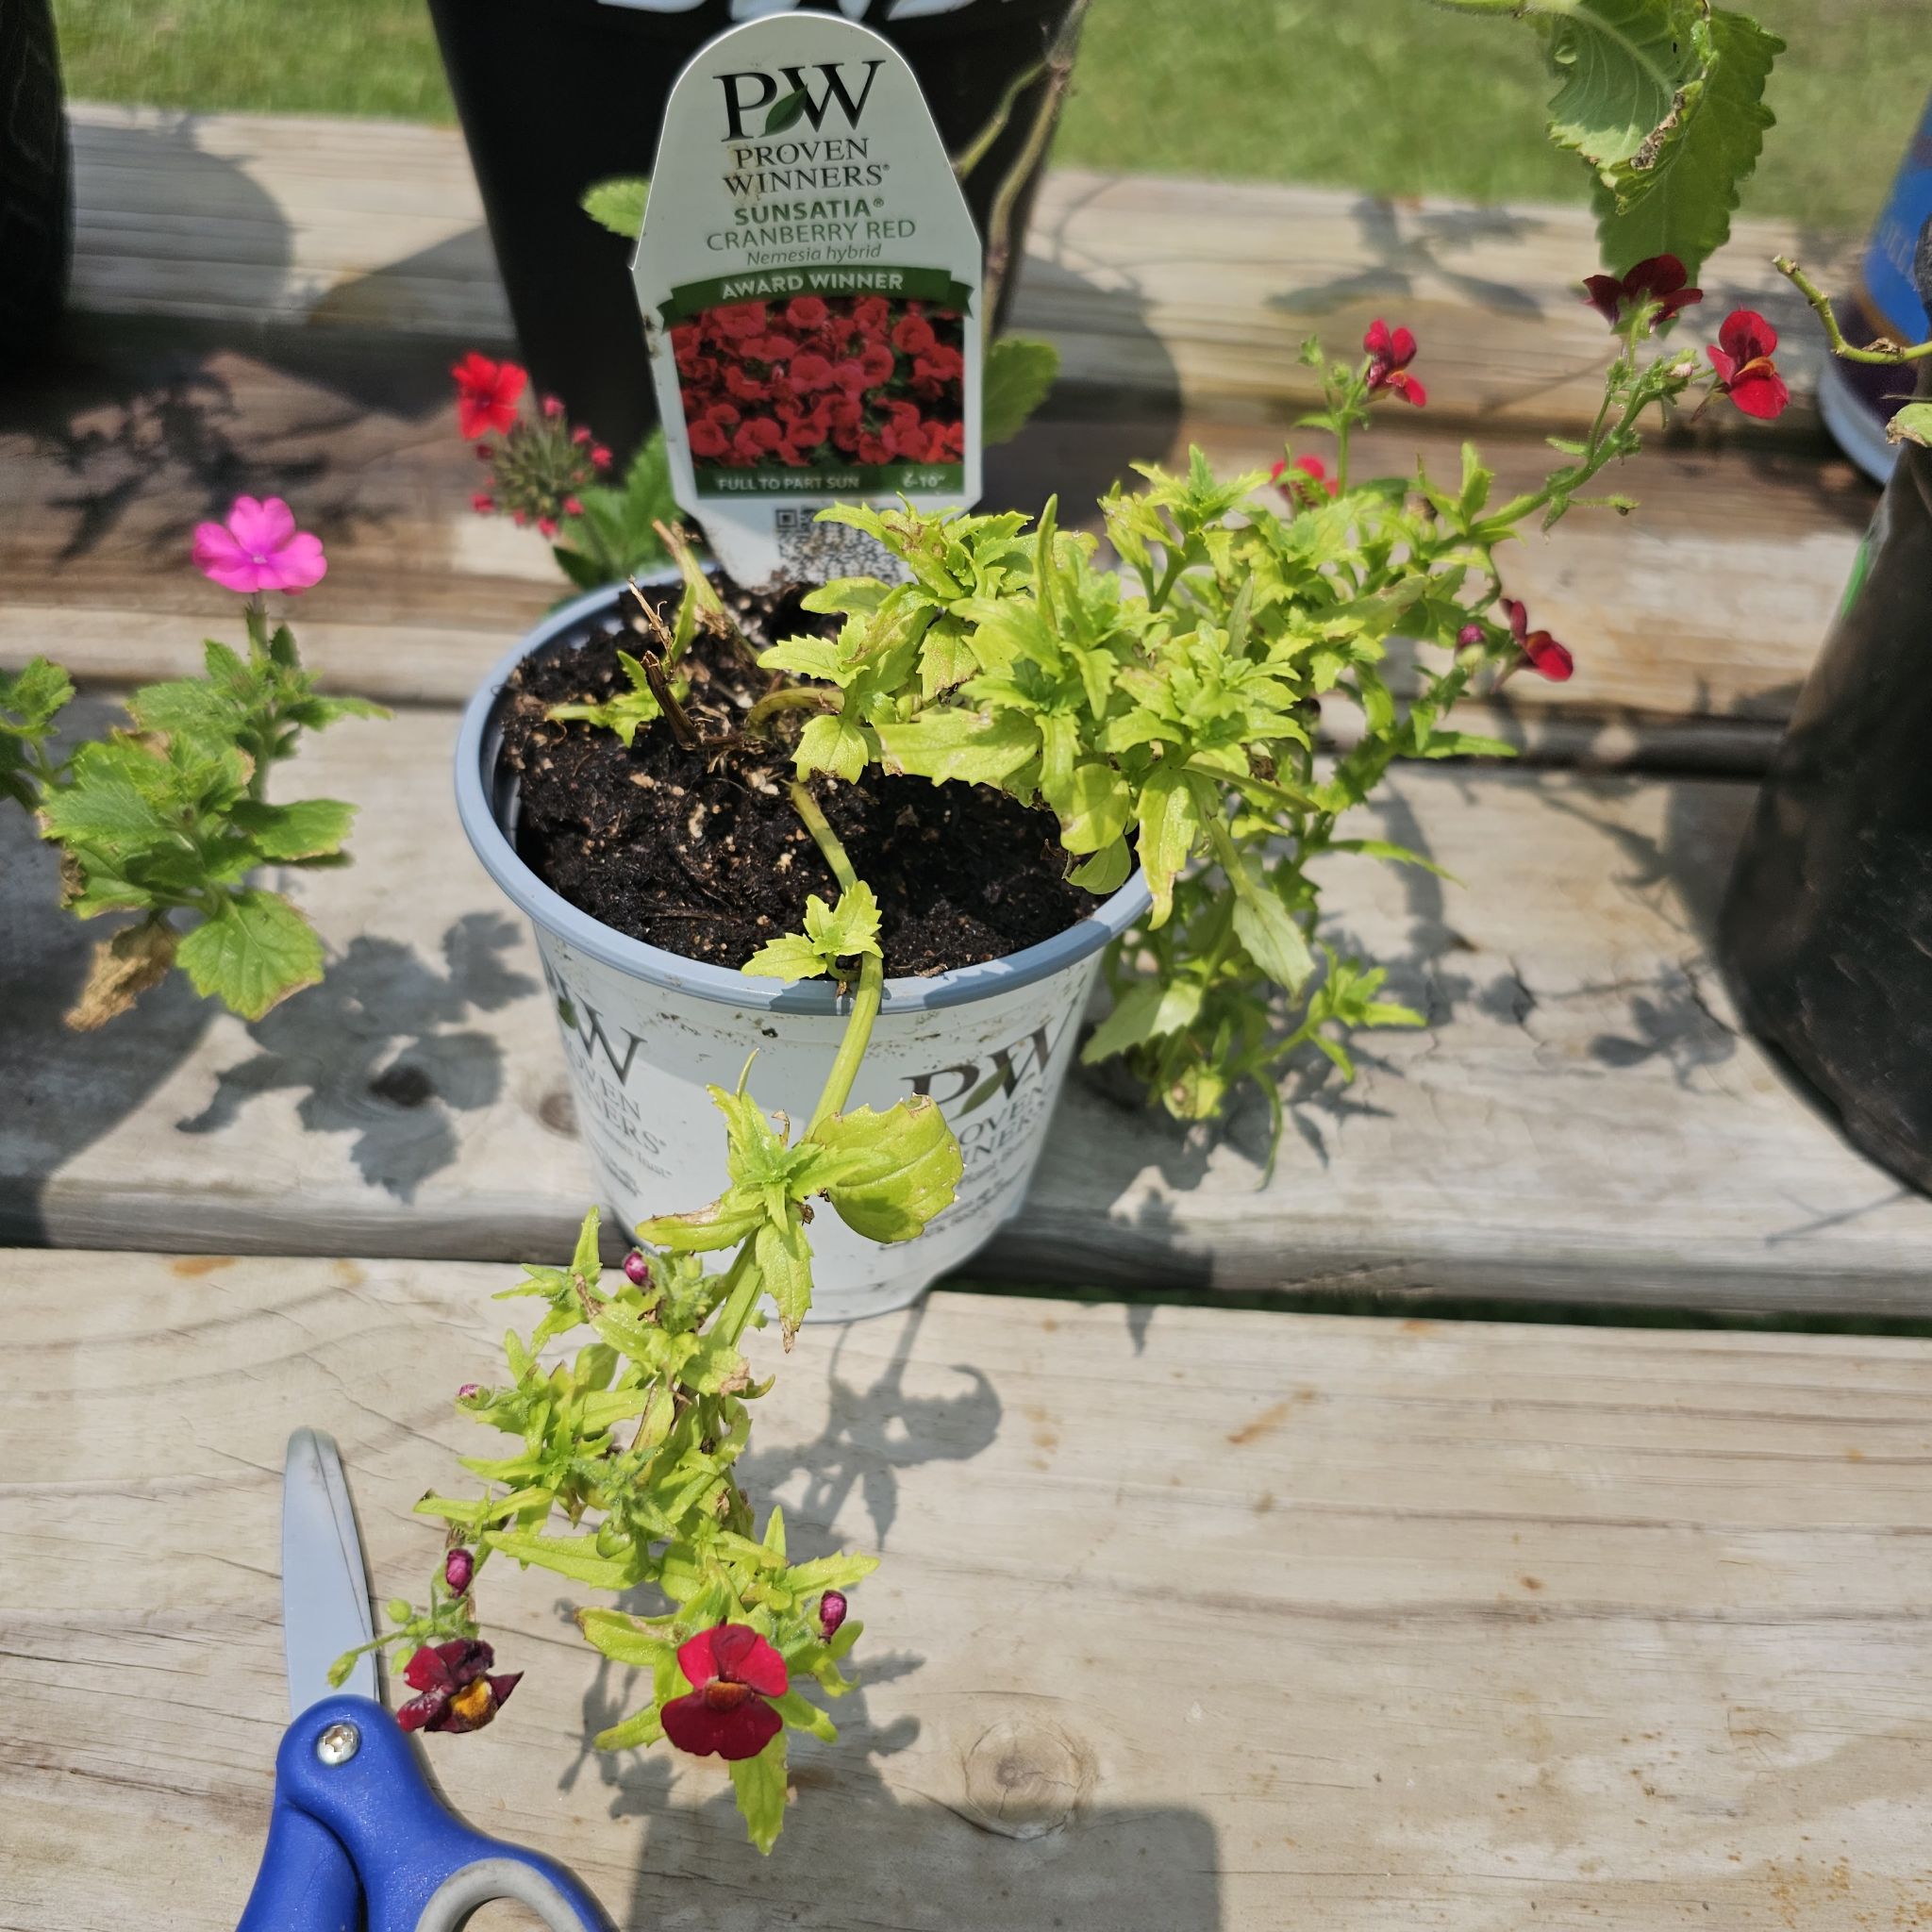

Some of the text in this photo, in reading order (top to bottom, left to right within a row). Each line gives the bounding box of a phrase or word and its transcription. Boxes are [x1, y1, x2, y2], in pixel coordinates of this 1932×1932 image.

[712, 59, 886, 142] PW
[734, 138, 869, 170] PROVEN
[707, 220, 916, 252] CRANBERRY RED
[746, 243, 882, 267] Nemesia hybrid
[722, 274, 904, 301] AWARD WINNER
[718, 478, 754, 491] FULL
[758, 477, 780, 489] TO
[784, 477, 823, 489] PART
[826, 475, 859, 489] SUN
